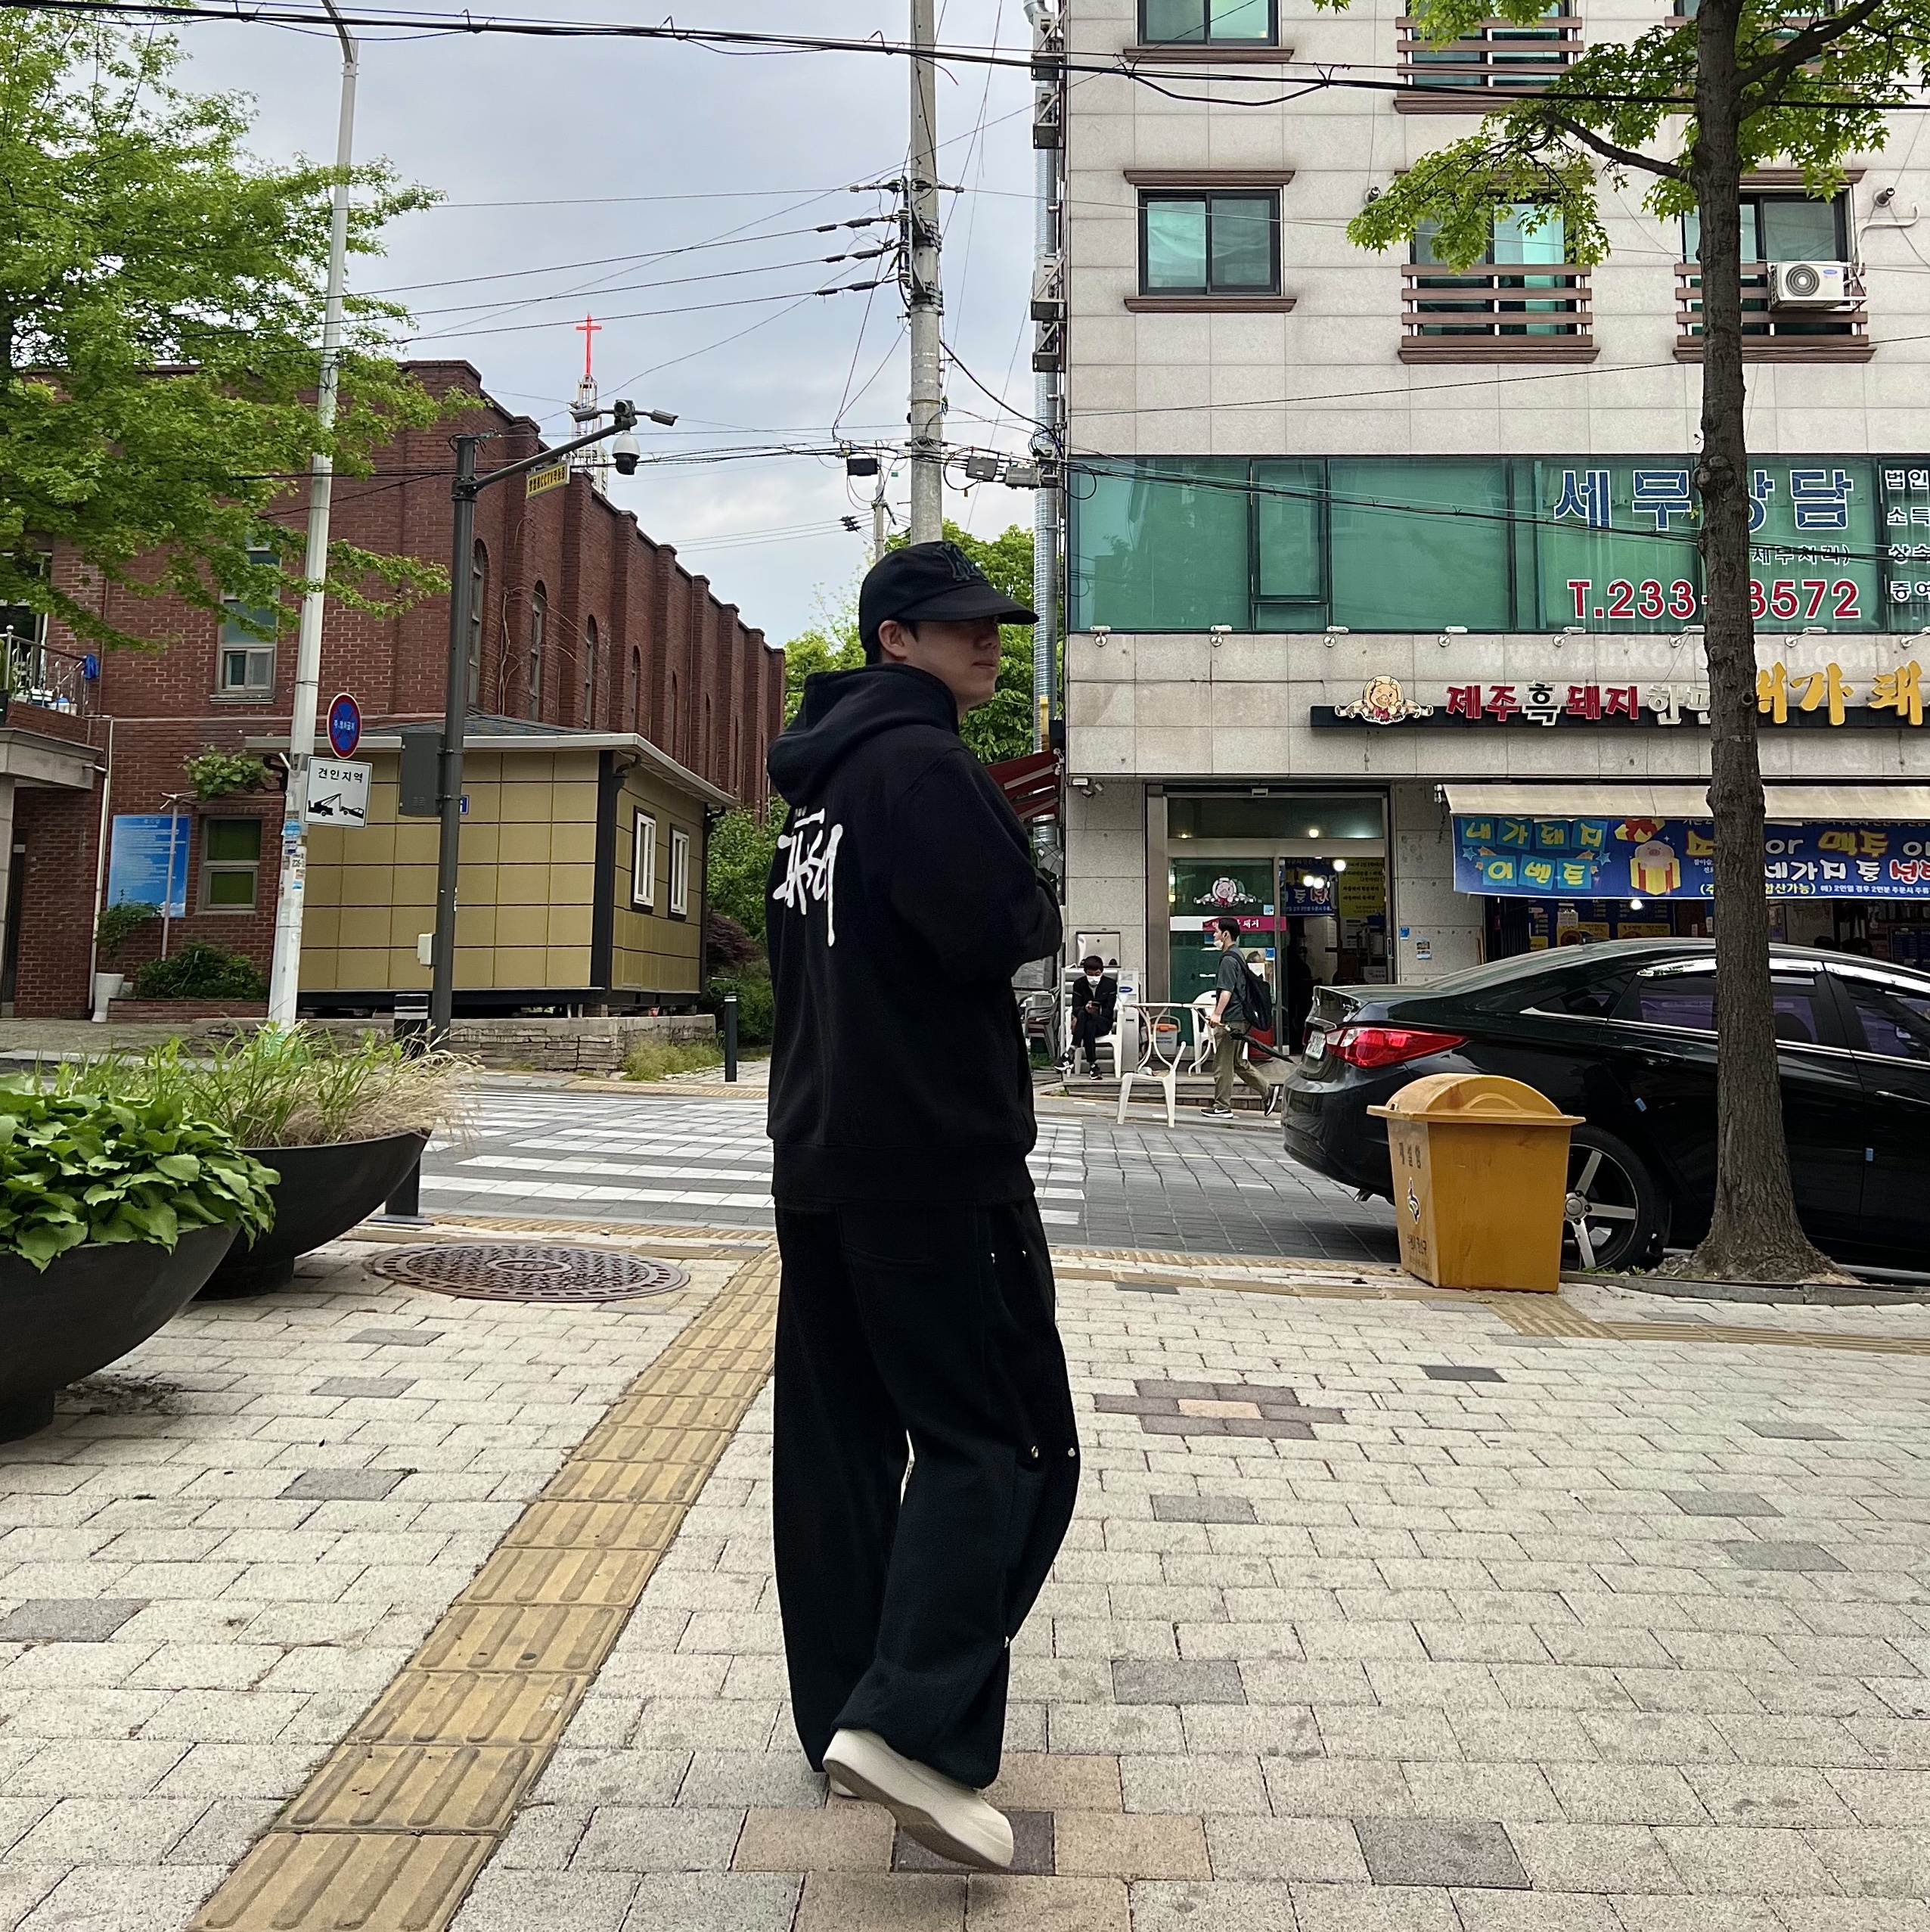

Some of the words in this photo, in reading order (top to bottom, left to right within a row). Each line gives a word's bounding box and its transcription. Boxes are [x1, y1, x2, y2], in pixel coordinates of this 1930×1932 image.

[318, 767, 363, 784] 견인지역
[1466, 822, 1603, 848] 내가돼지
[1764, 839, 1804, 855] or
[1487, 861, 1586, 886] 이벤트
